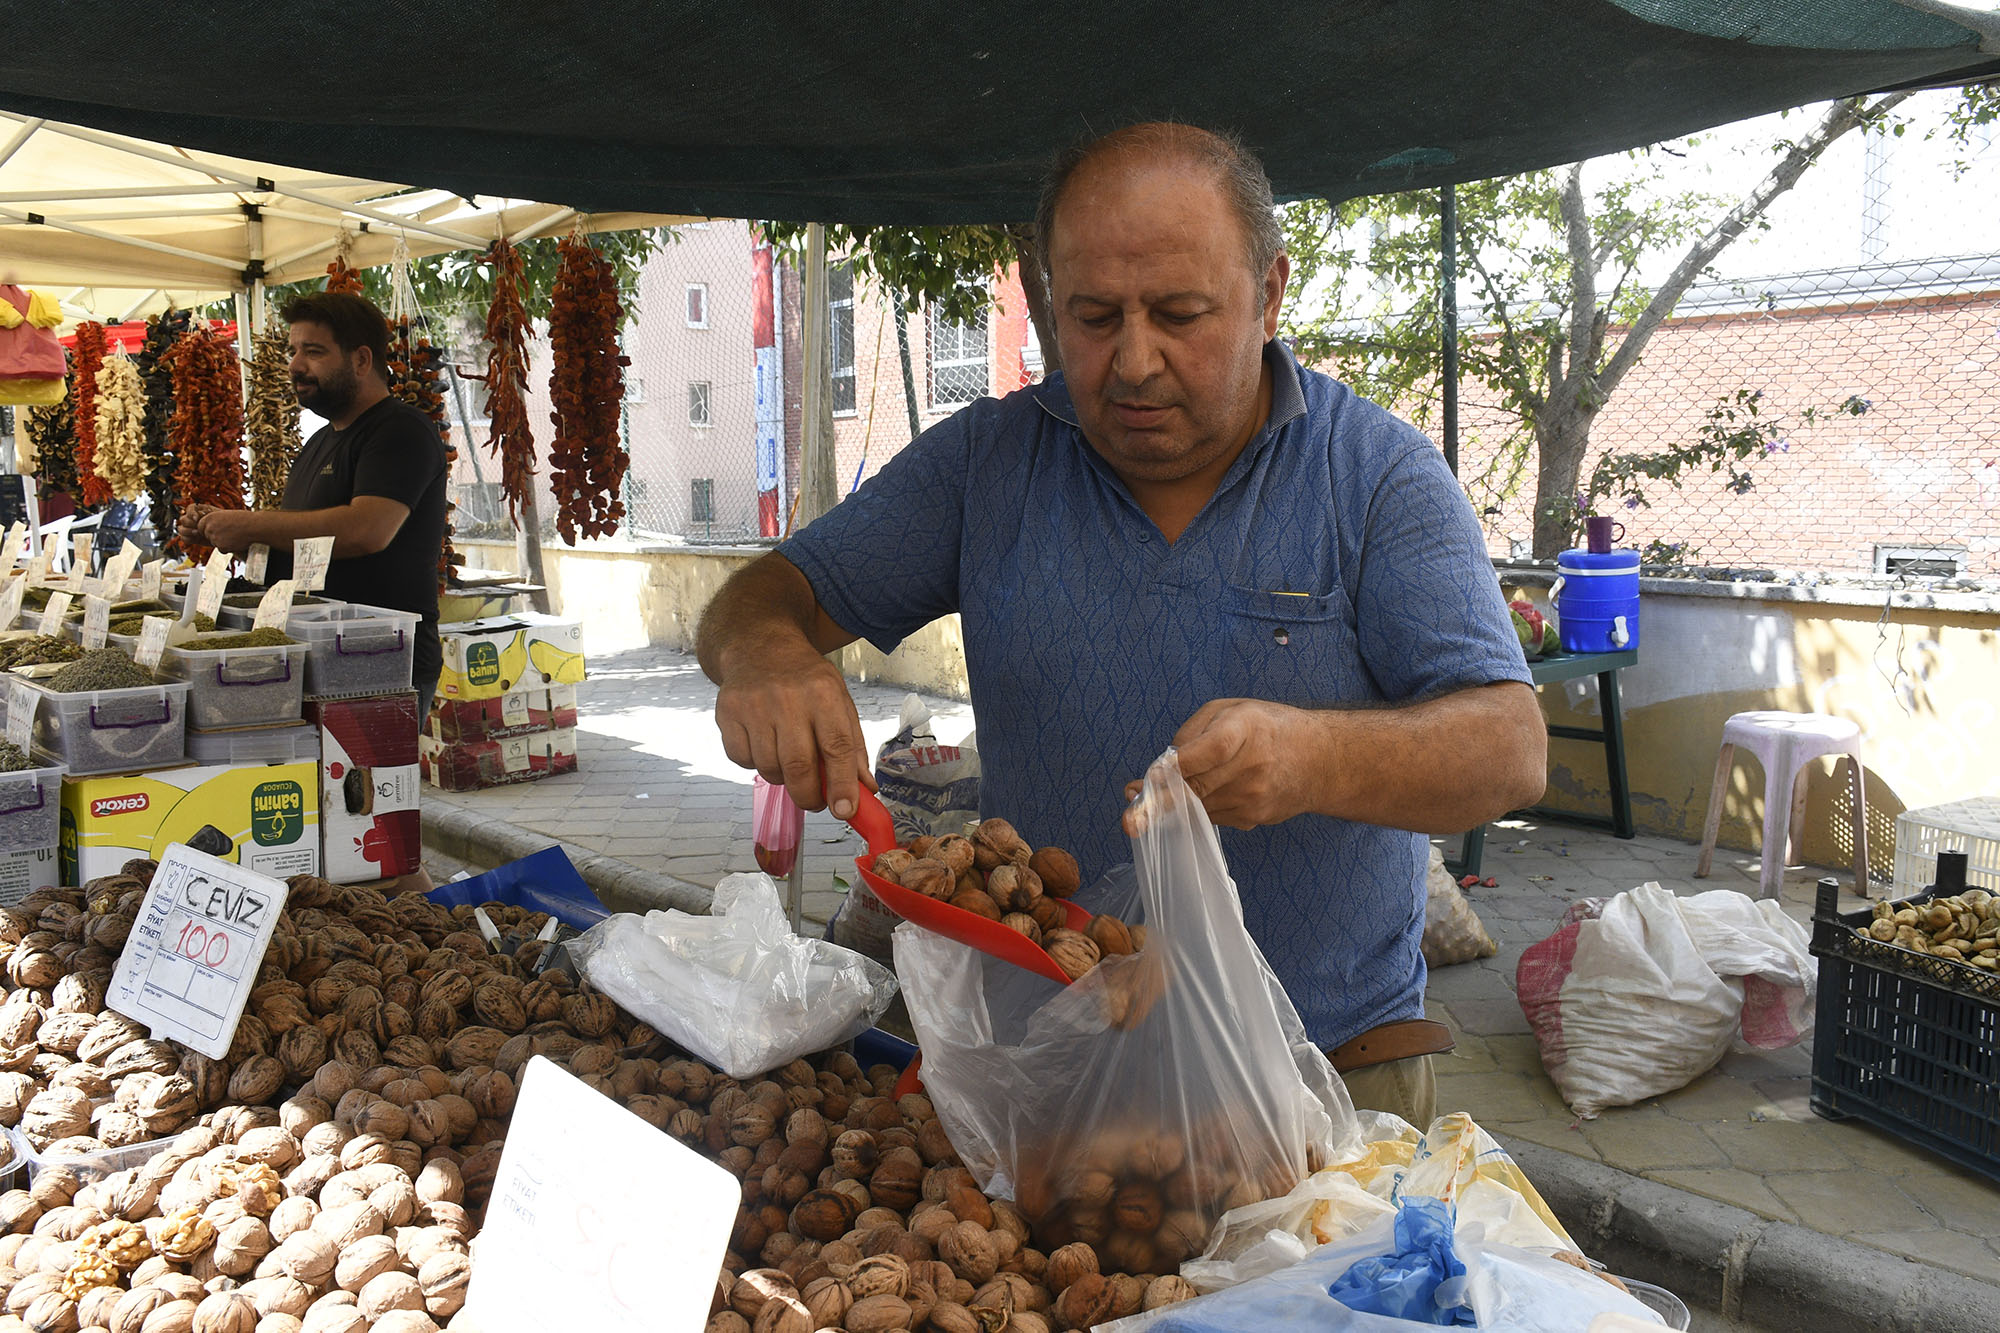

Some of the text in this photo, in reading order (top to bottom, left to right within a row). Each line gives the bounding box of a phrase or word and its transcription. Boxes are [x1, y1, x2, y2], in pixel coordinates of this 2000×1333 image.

[263, 782, 292, 792] ECUADOR
[254, 793, 299, 812] Banini
[146, 912, 164, 927] FİYAT
[139, 924, 162, 940] ETİKETİ
[176, 919, 229, 967] 100
